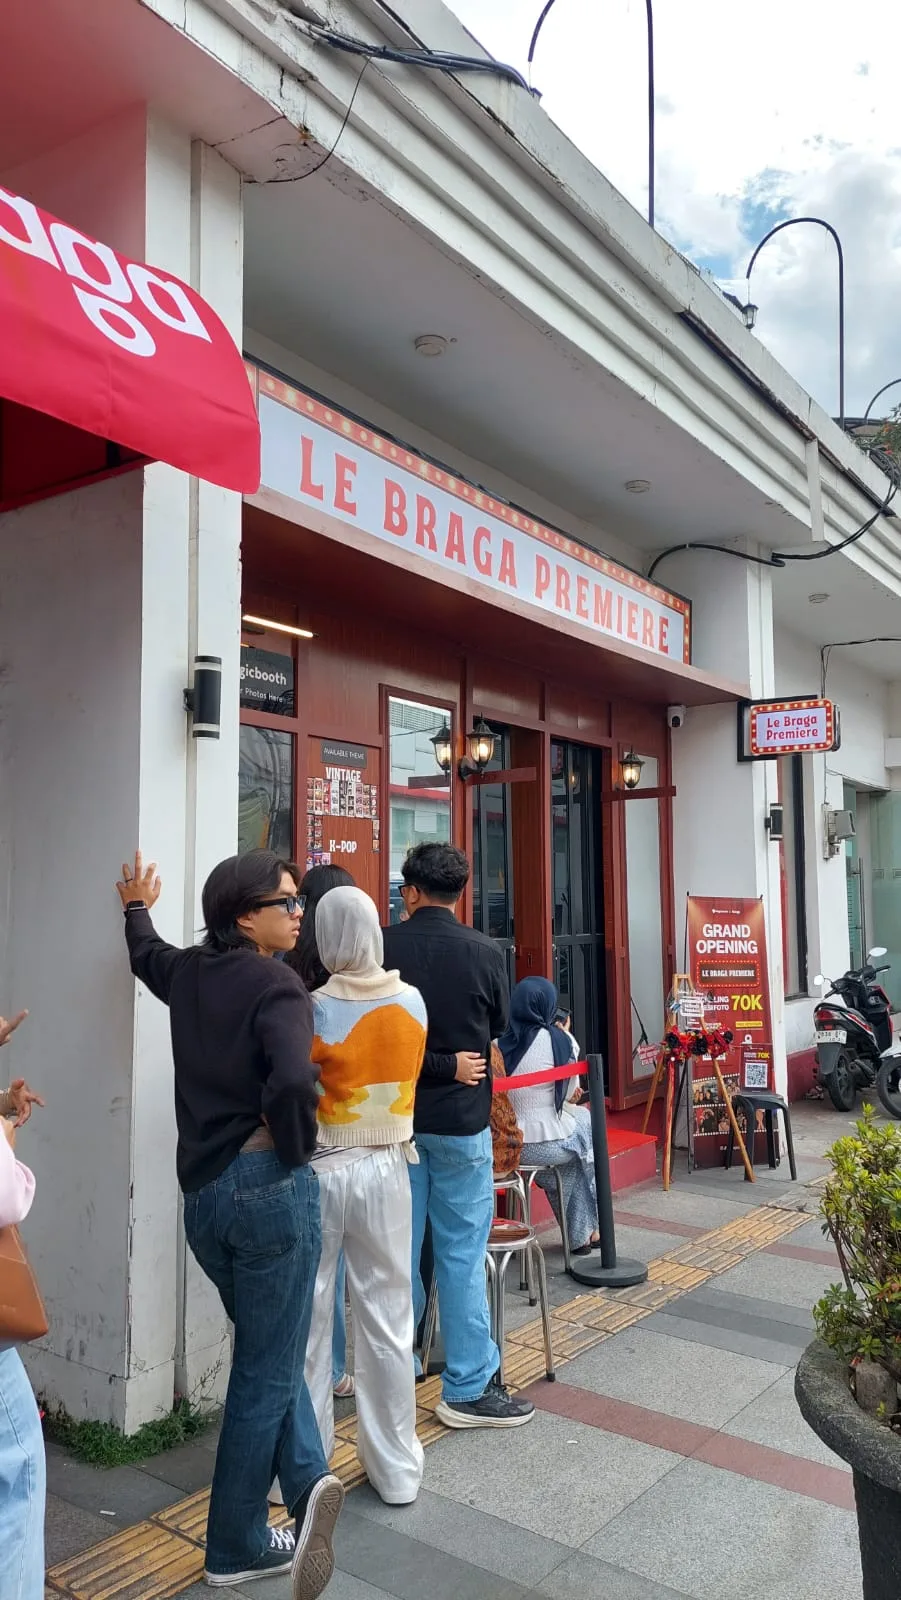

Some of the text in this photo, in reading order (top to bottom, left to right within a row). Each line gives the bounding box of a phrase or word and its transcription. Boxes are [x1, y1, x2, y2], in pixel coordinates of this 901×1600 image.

[0, 190, 212, 357] aga
[300, 434, 669, 655] LE BRAGA PREMIERE
[240, 664, 287, 685] gicbooth
[767, 714, 817, 728] Le Braga
[766, 727, 818, 741] Premiere
[323, 747, 348, 758] AVAILABLE
[325, 766, 362, 783] VINTAGE
[329, 839, 358, 853] K-POP
[702, 923, 751, 938] GRAND
[695, 940, 758, 954] OPENING
[701, 969, 755, 977] LE BRAGA PREMIERE
[731, 994, 763, 1011] 70K
